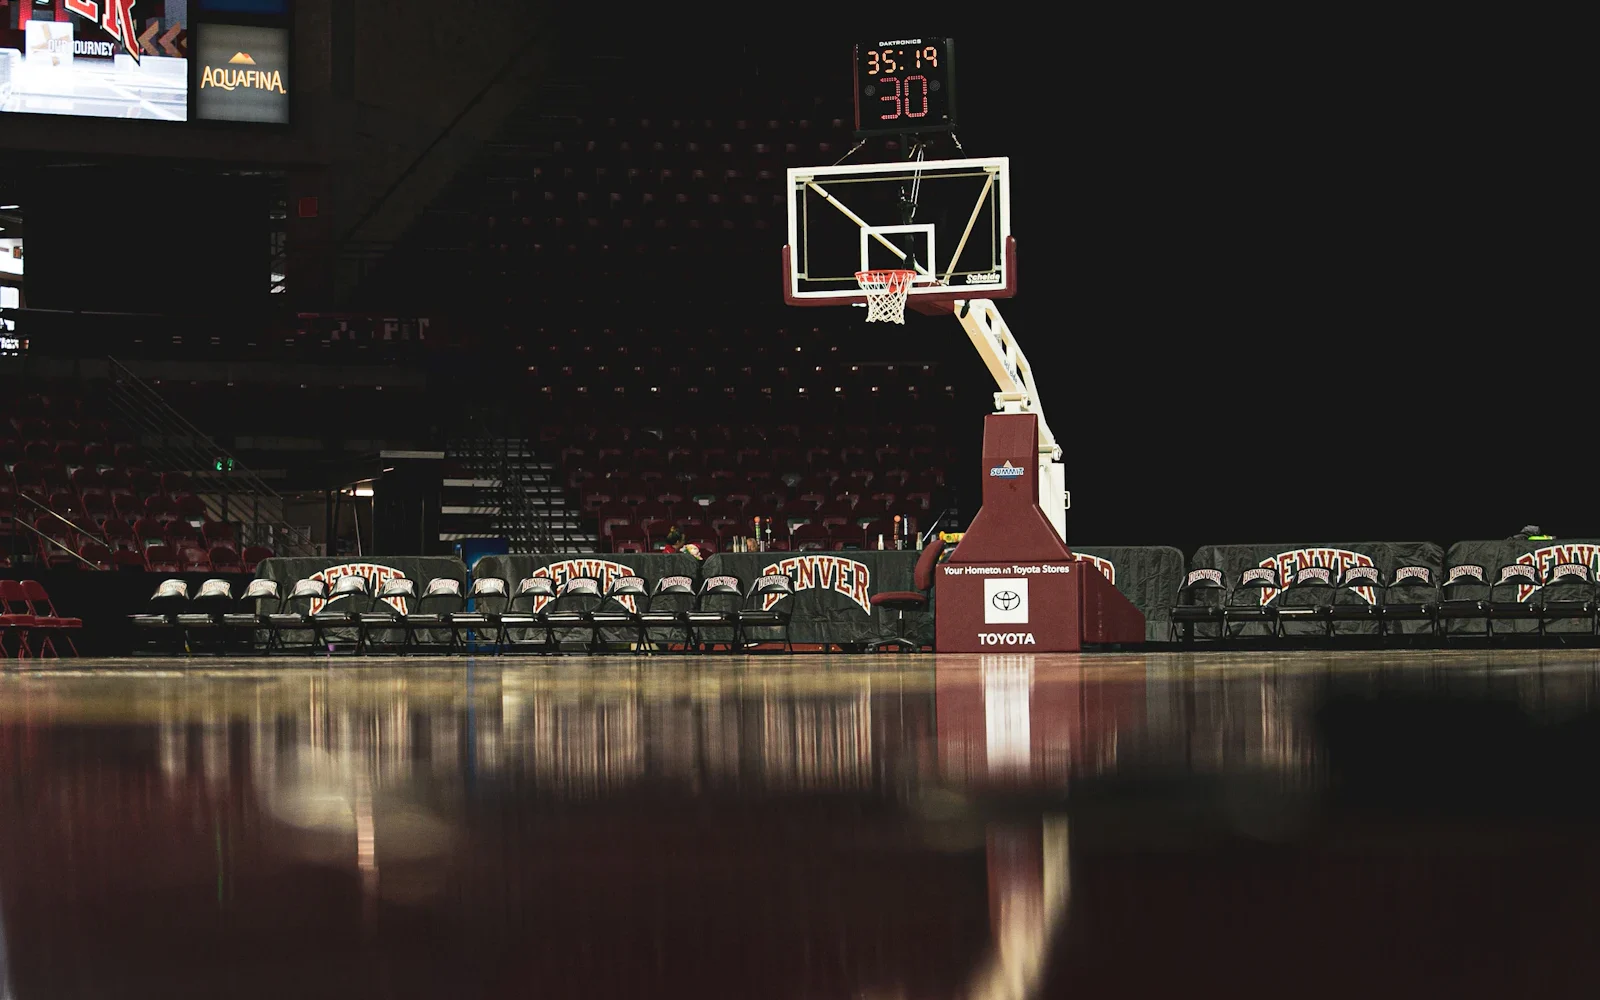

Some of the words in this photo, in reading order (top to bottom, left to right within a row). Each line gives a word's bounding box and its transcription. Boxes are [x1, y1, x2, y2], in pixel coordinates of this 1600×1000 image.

[879, 39, 921, 47] DAKTRONICS
[867, 46, 938, 75] 35:19
[200, 65, 285, 95] AQUAFINA
[880, 75, 928, 120] 30
[990, 467, 1024, 477] SUMMIT
[944, 566, 963, 575] Your
[1013, 565, 1040, 576] Toyota
[1042, 564, 1070, 574] Stores
[1188, 568, 1222, 586] DENVER
[1242, 568, 1275, 586] DENVER
[1297, 568, 1329, 585] DENVER
[1345, 567, 1378, 584] DENVER
[1396, 566, 1429, 584] DENVER
[1449, 565, 1483, 582] DENVER
[1501, 564, 1535, 582] DENVER
[1553, 564, 1587, 582] DENVER
[758, 575, 789, 592] DENVER
[978, 633, 1036, 646] TOYOTA
